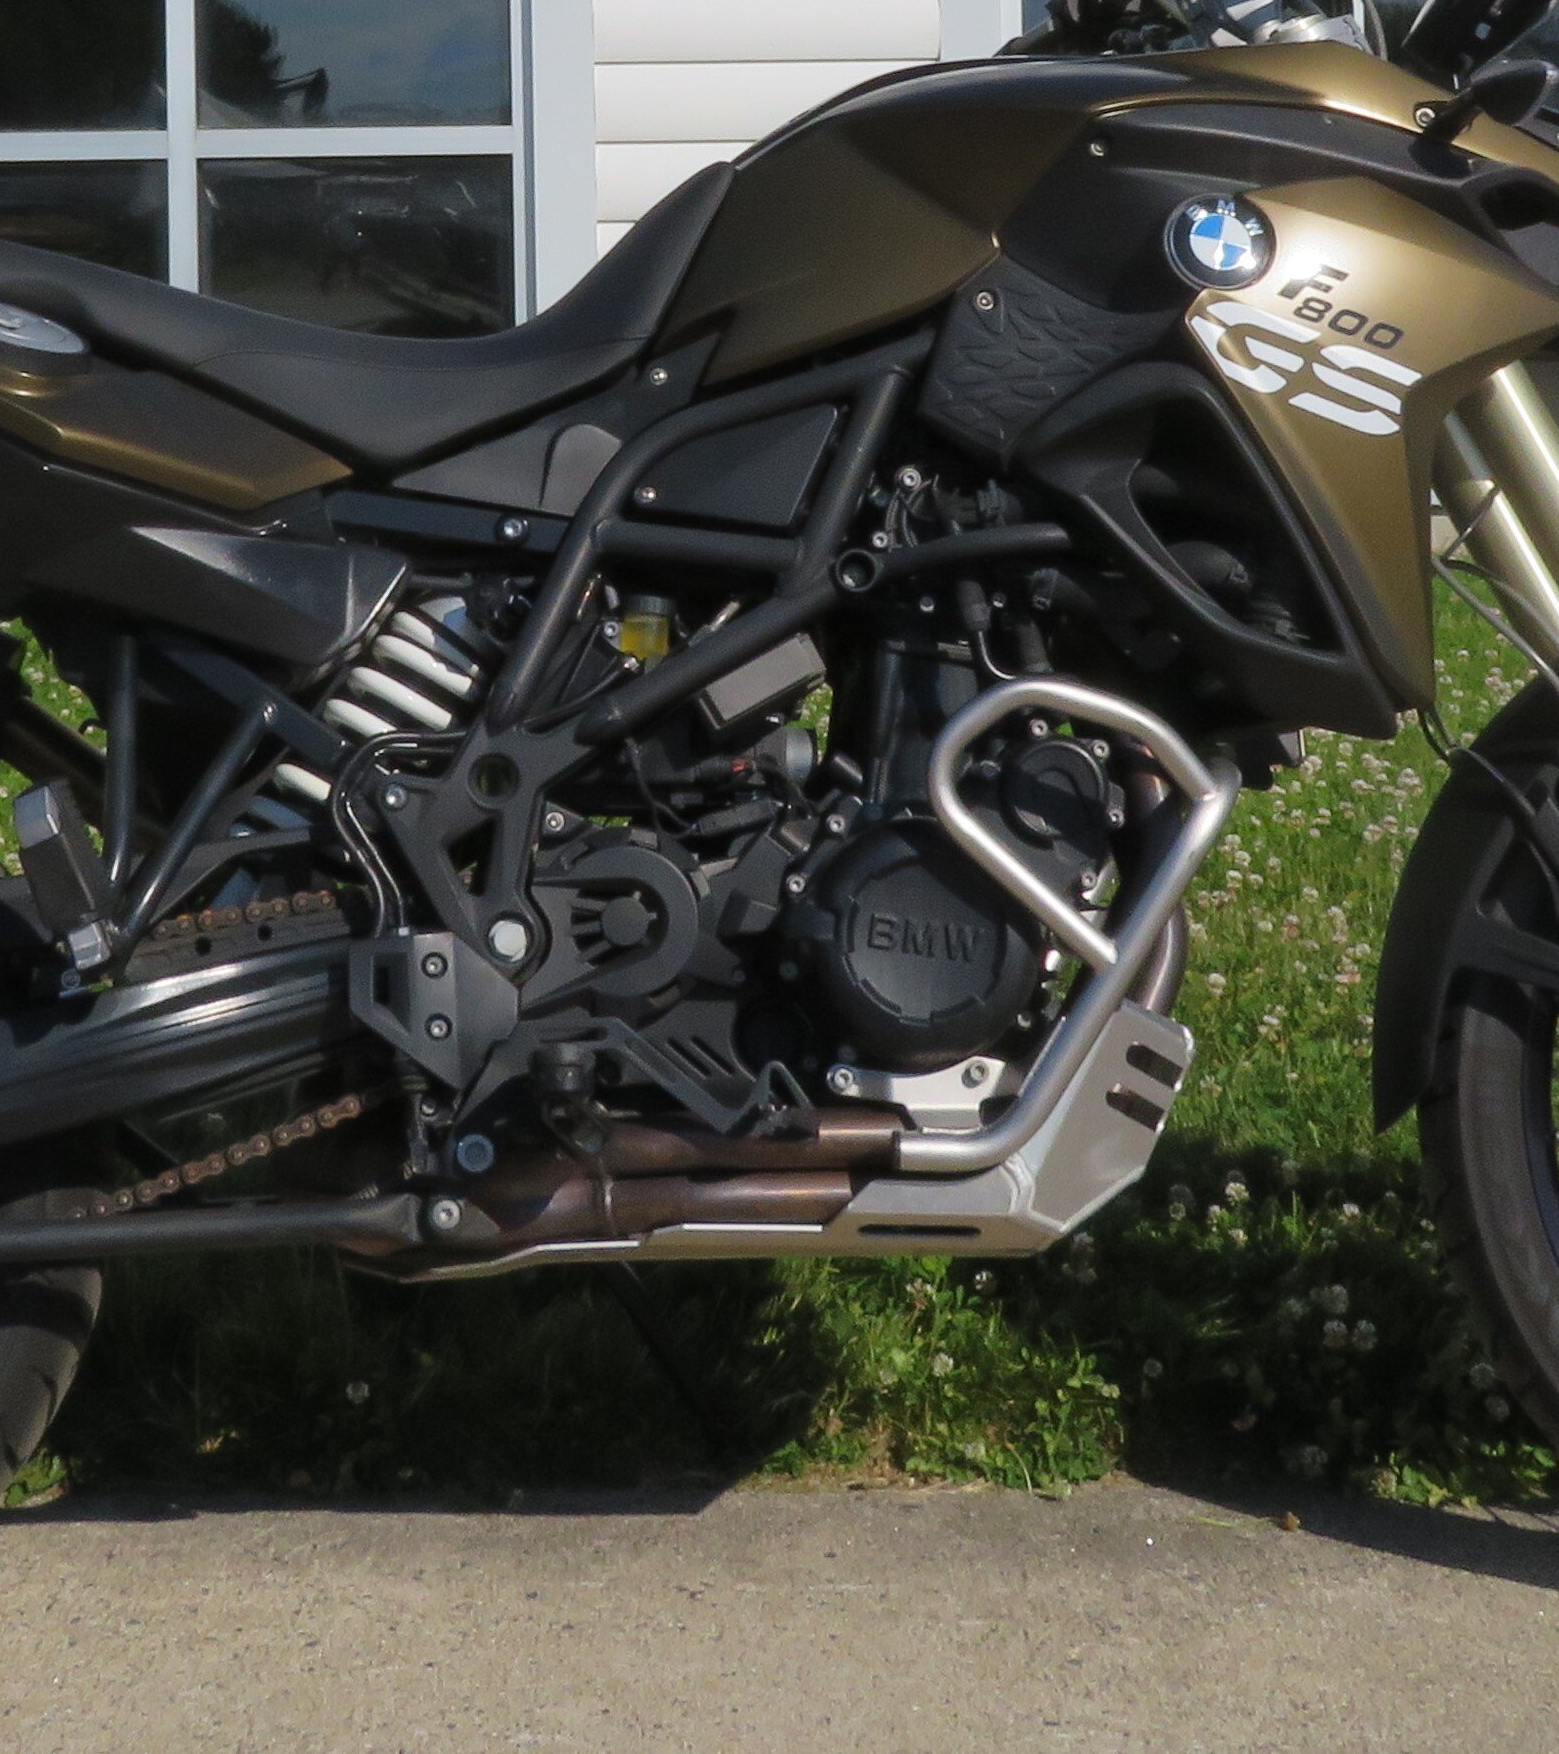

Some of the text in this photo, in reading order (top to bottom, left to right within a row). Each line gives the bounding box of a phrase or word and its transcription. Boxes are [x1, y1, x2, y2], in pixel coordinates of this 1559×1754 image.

[1186, 199, 1264, 237] BMW
[1277, 264, 1350, 301] F
[1294, 296, 1404, 350] 800
[1189, 301, 1423, 437] GS
[867, 911, 986, 964] BMW
